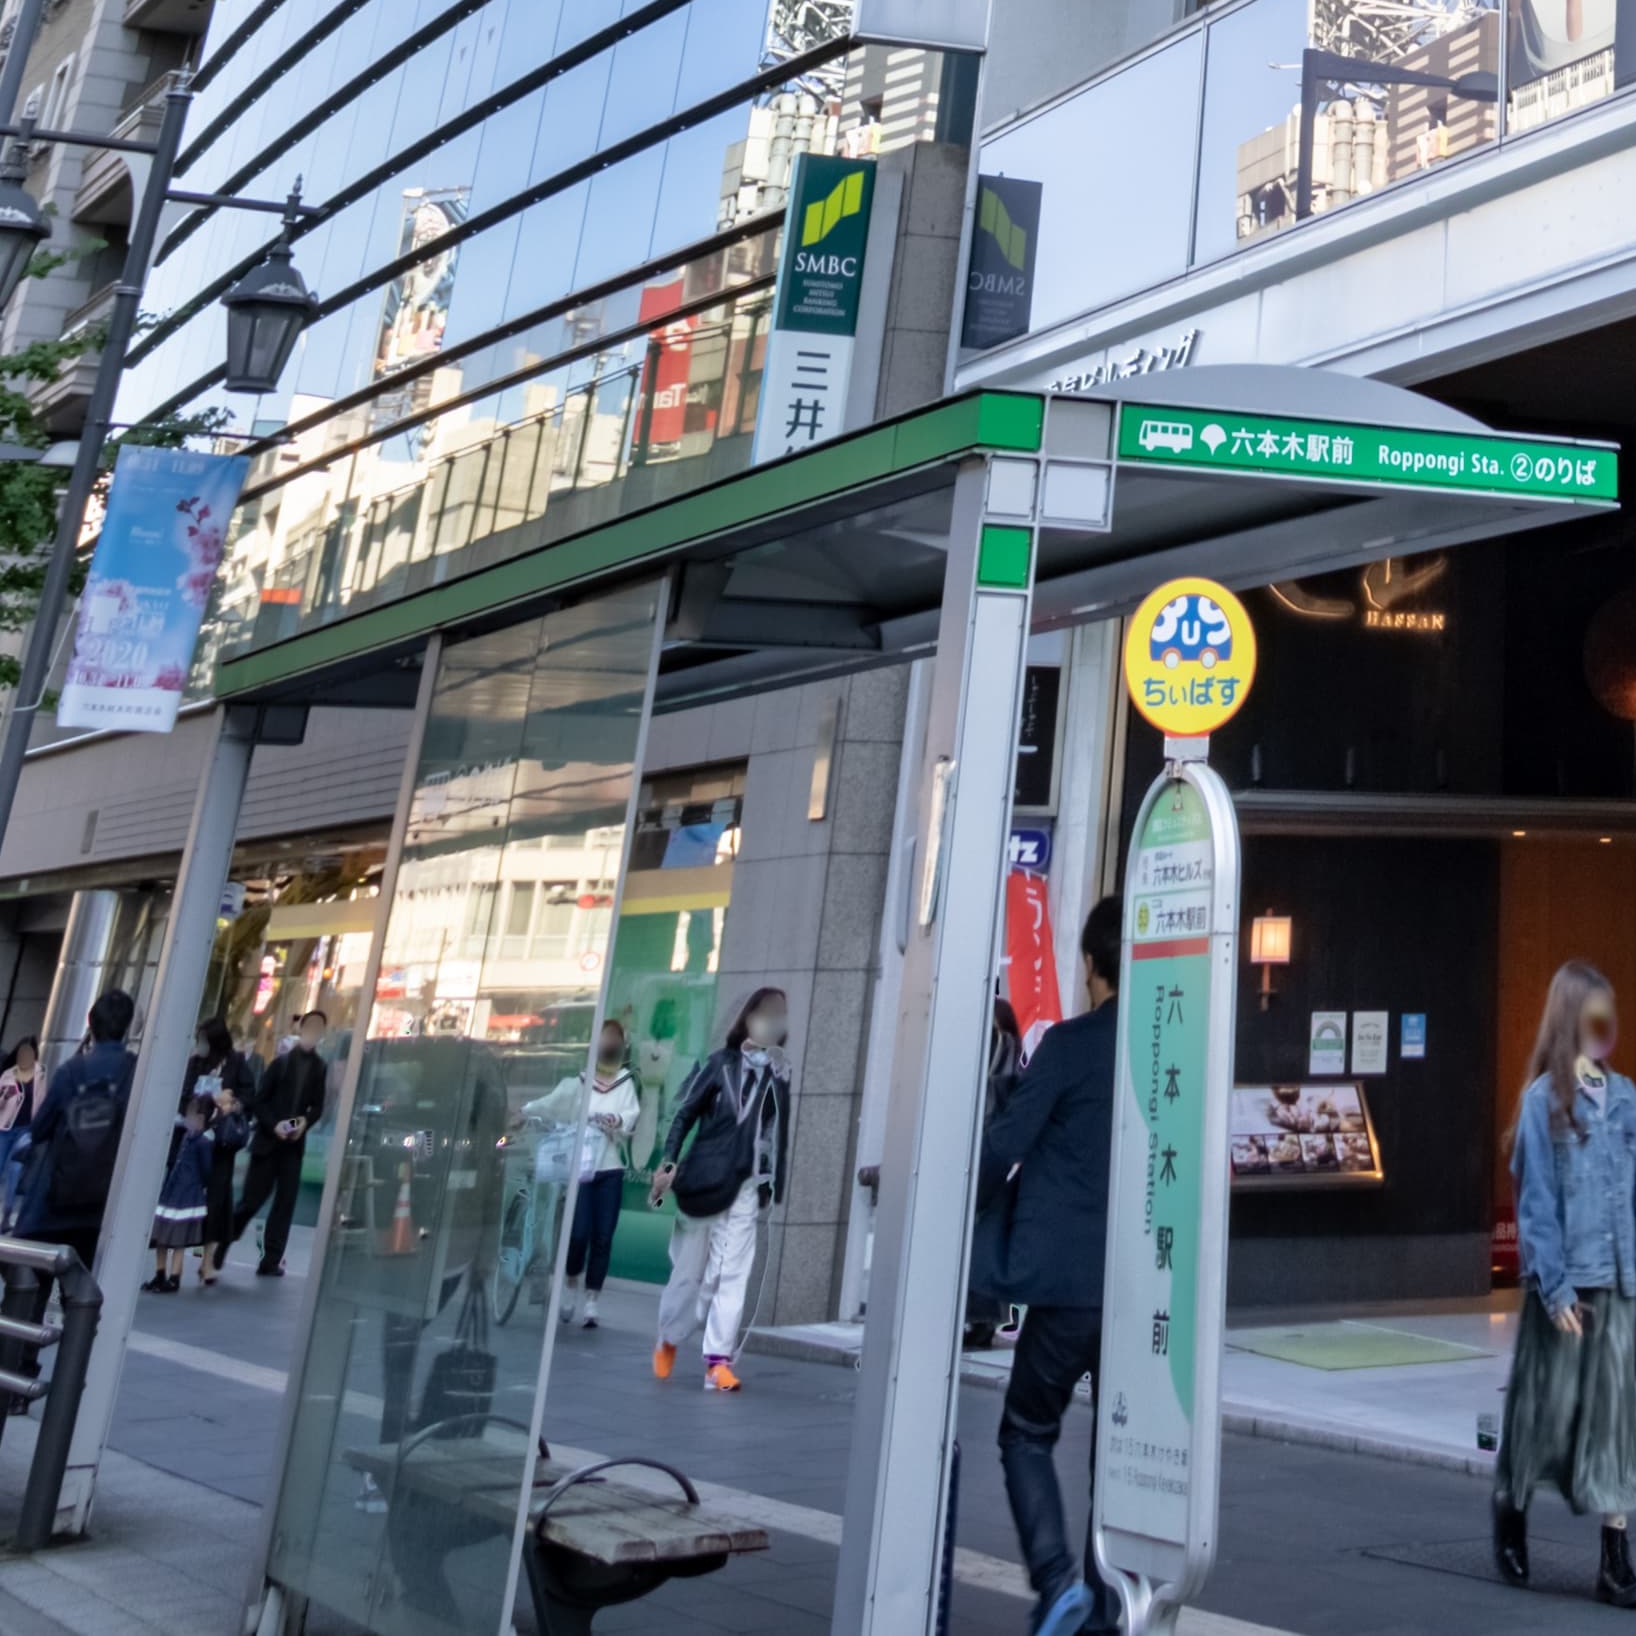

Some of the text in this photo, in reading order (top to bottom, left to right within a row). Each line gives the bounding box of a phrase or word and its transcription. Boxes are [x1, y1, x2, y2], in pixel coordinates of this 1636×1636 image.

[795, 252, 856, 277] SMBC
[1231, 429, 1354, 466] 六本木駅前
[1378, 444, 1465, 477] Roppongi
[1471, 453, 1504, 476] Sta.
[1366, 610, 1446, 630] HASSAN
[1144, 985, 1165, 1236] Roppongi Station
[1152, 984, 1184, 1356] 六本木駅前
